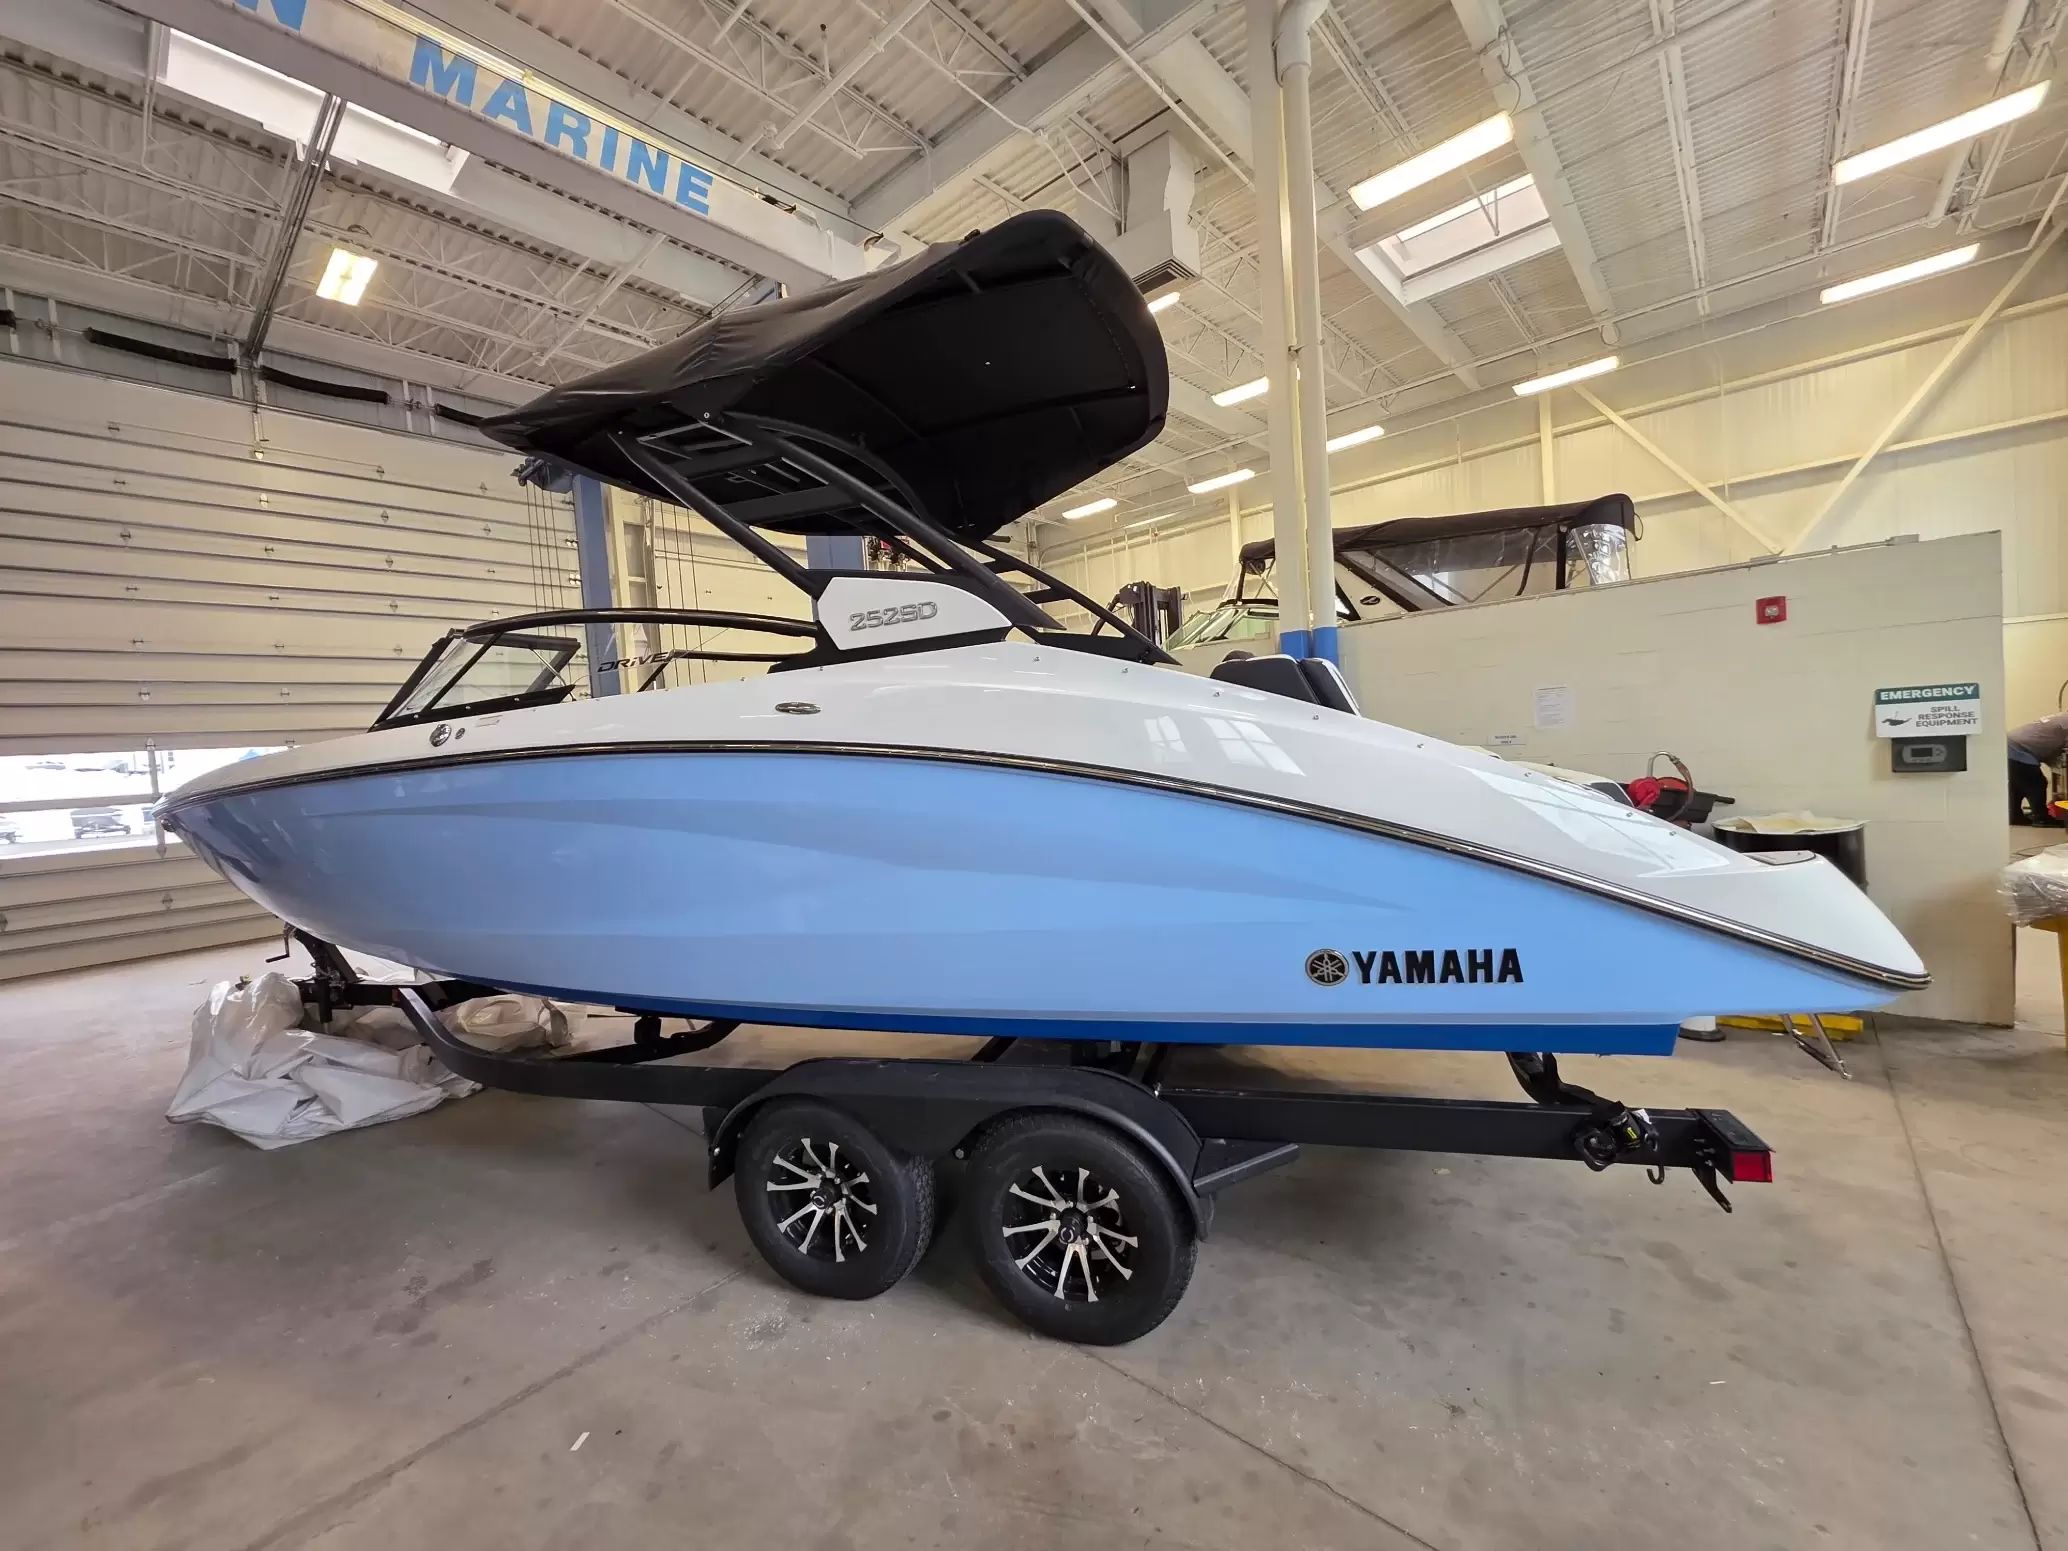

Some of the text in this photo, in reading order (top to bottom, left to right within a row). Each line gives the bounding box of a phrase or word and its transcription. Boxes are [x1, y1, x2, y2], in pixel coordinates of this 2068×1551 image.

[408, 32, 714, 217] MARINE
[848, 601, 939, 632] 252SD
[1880, 686, 1975, 701] EMERGENCY
[1918, 711, 1975, 720] RESPONSE
[1930, 705, 1961, 713] SPILL
[1915, 718, 1979, 727] EQUIPMENT
[1352, 948, 1525, 984] YAMAHA
